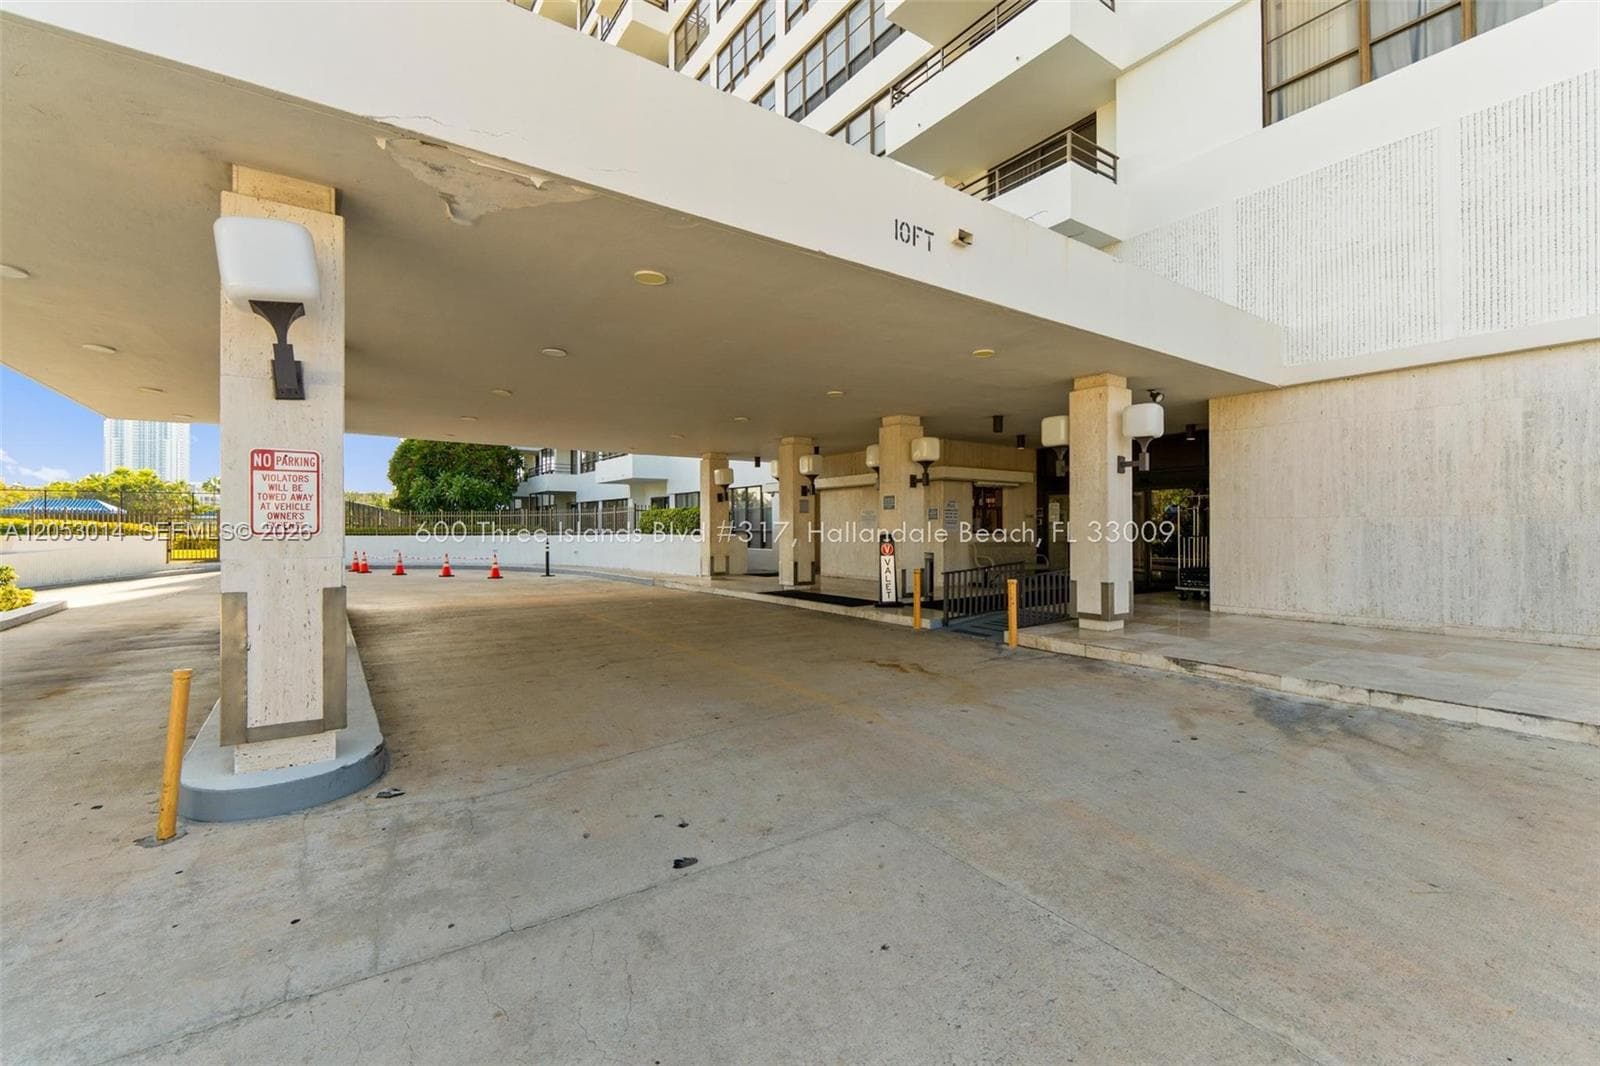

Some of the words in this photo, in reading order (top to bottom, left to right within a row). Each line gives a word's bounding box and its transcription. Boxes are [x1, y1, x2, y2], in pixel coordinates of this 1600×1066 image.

[894, 218, 935, 252] 10FT
[253, 453, 272, 467] NO
[276, 455, 316, 467] PARKING
[261, 474, 310, 483] VIOLATORS
[268, 483, 288, 492] WILL
[292, 484, 303, 492] BE
[257, 492, 287, 501] TOWED
[290, 494, 314, 502] AWAY
[260, 502, 271, 510] AT
[274, 502, 311, 511] VEHICLE
[267, 511, 305, 520] OWNER'S
[884, 558, 892, 599] VALET
